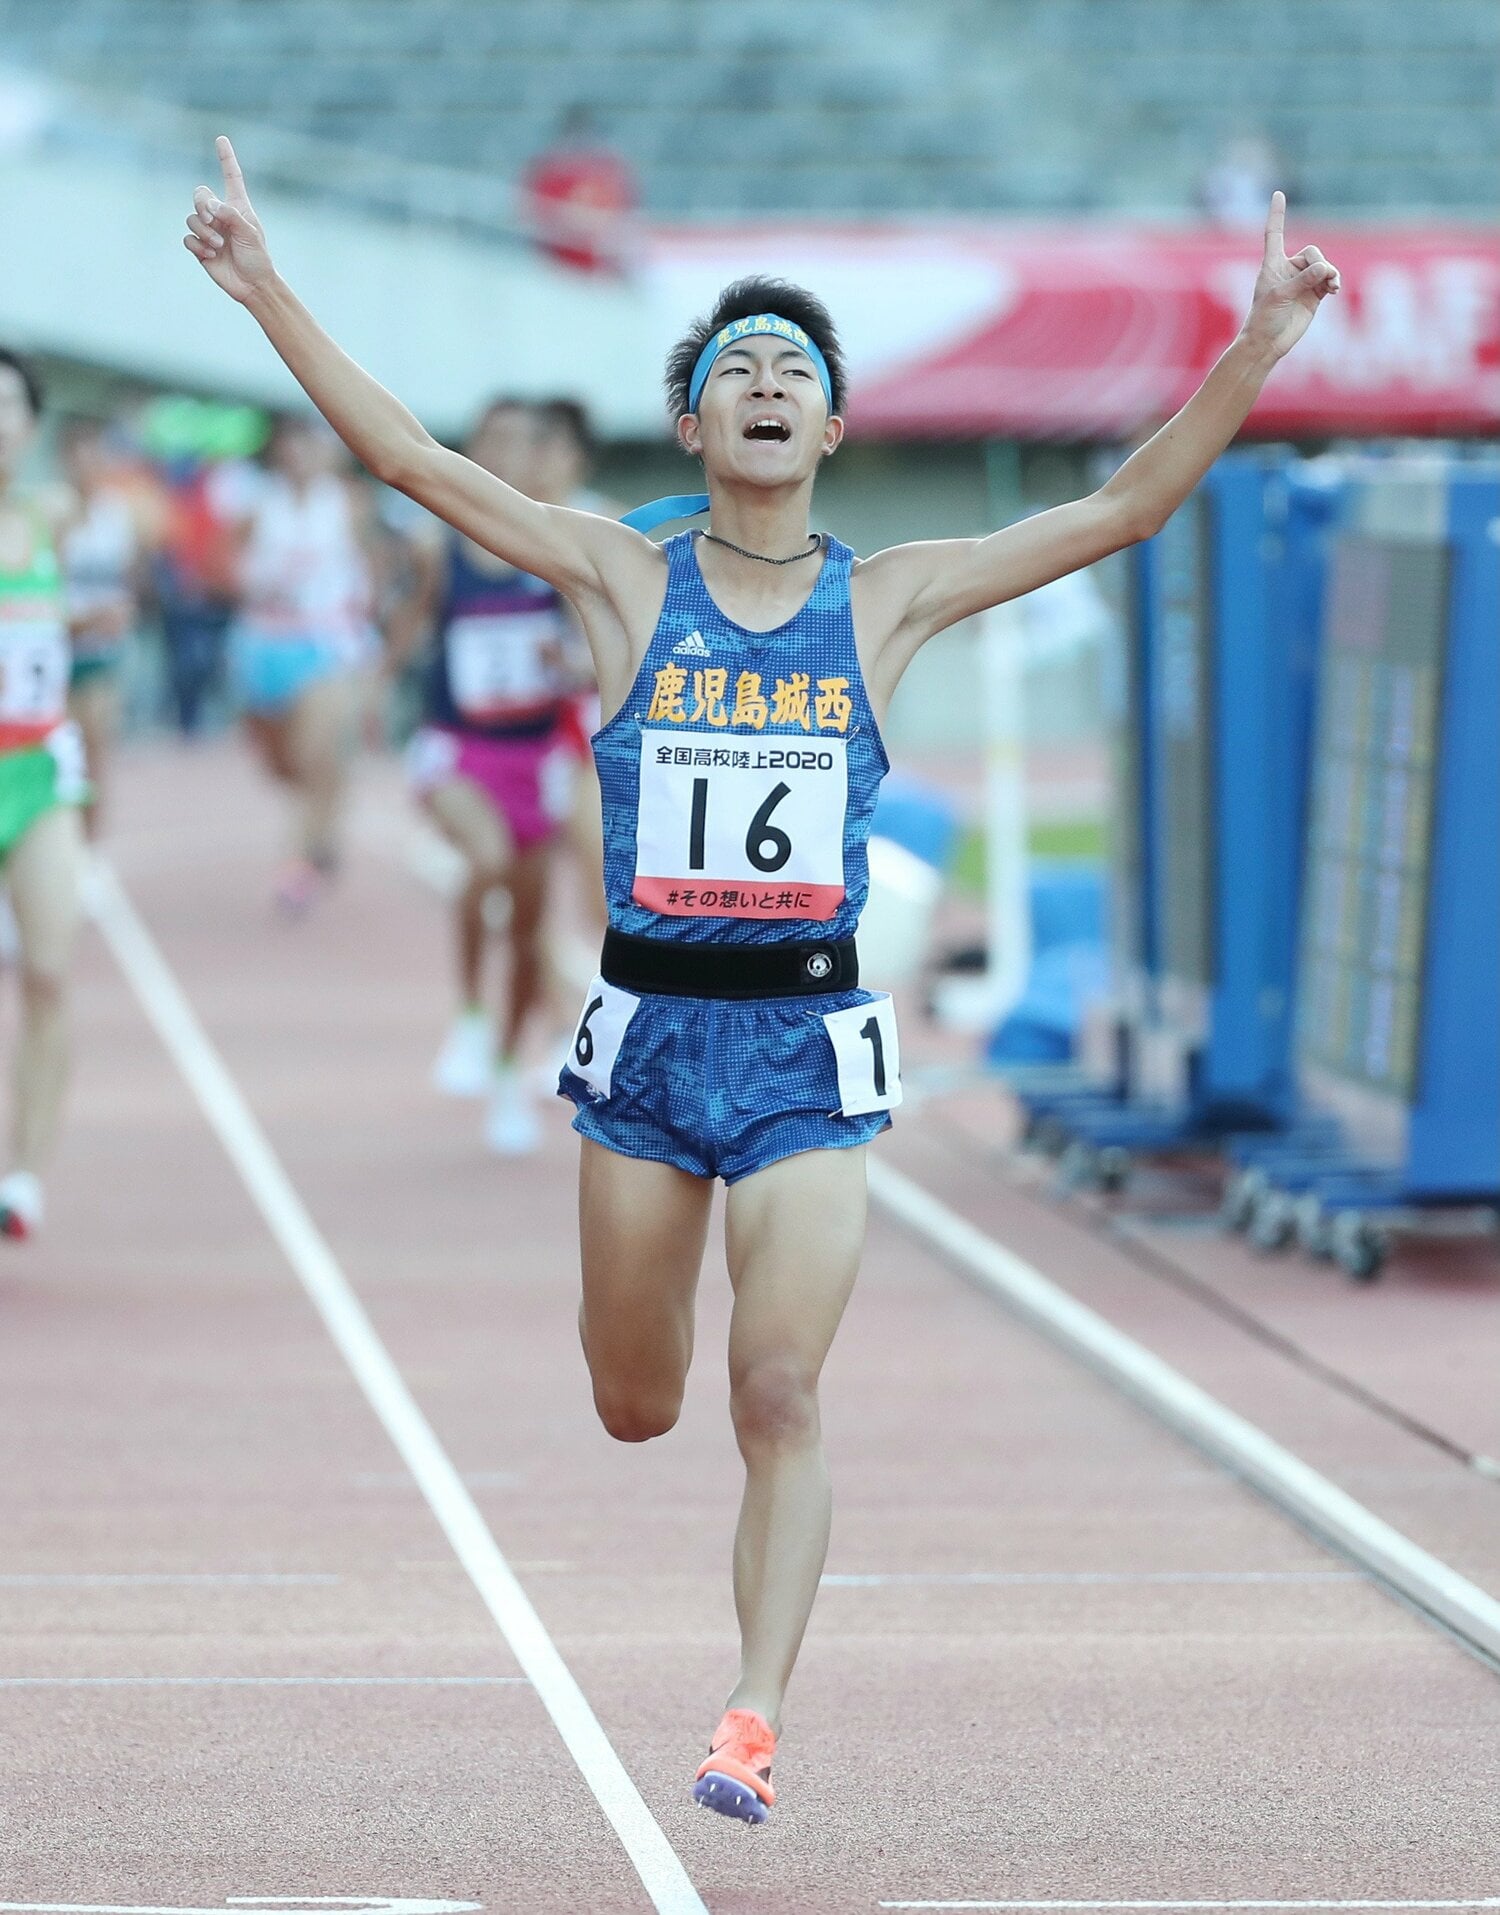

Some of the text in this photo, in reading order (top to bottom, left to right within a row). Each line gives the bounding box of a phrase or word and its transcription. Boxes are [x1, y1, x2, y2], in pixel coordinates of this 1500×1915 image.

[673, 644, 711, 657] adidas
[647, 662, 853, 733] 鹿児島城西
[655, 746, 833, 770] 全国高校陸上2020
[689, 778, 792, 872] 16
[666, 889, 811, 909] #その想いと共に
